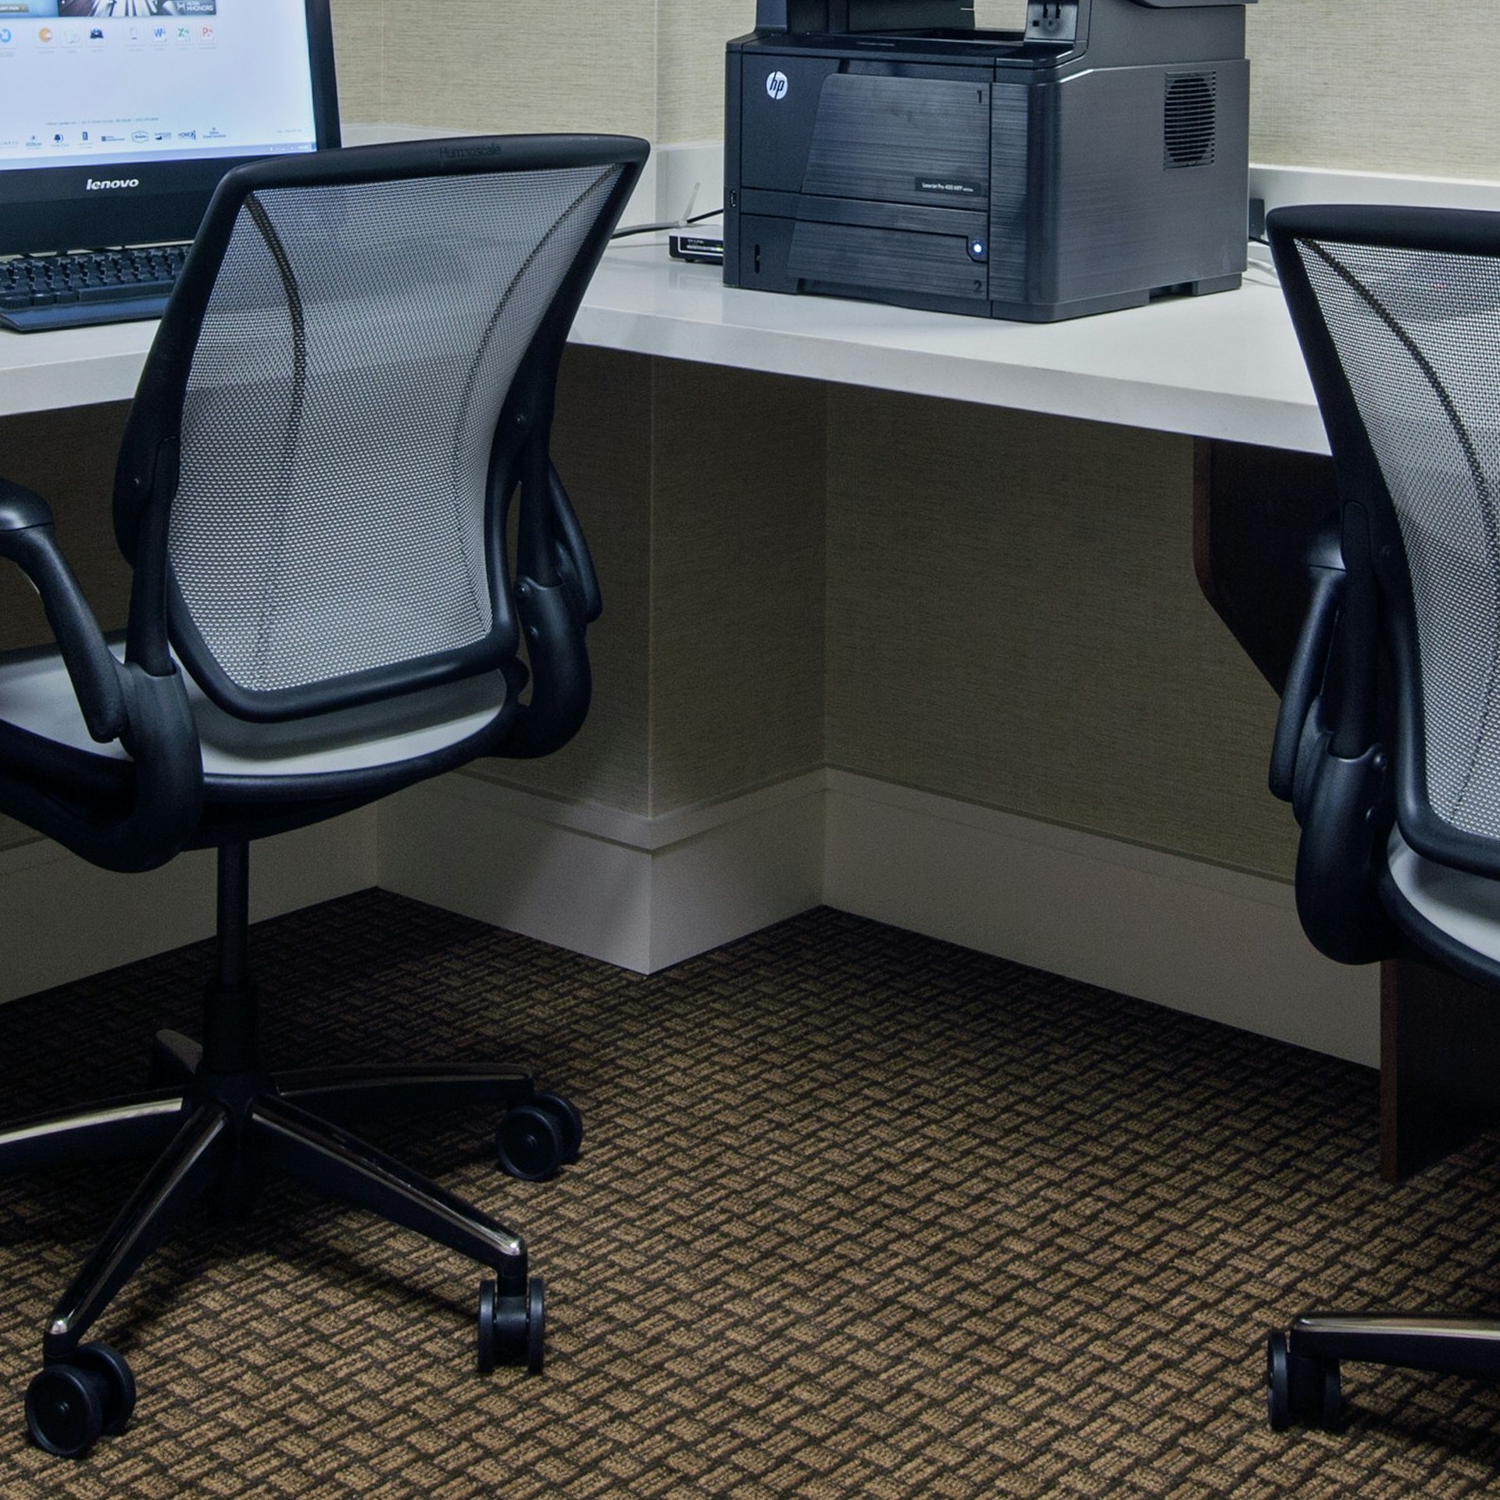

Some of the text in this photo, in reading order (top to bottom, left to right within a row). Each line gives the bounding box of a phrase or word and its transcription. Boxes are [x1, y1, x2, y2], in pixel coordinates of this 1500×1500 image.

[767, 71, 788, 100] hp
[977, 90, 982, 103] 1
[86, 178, 139, 191] lenovo
